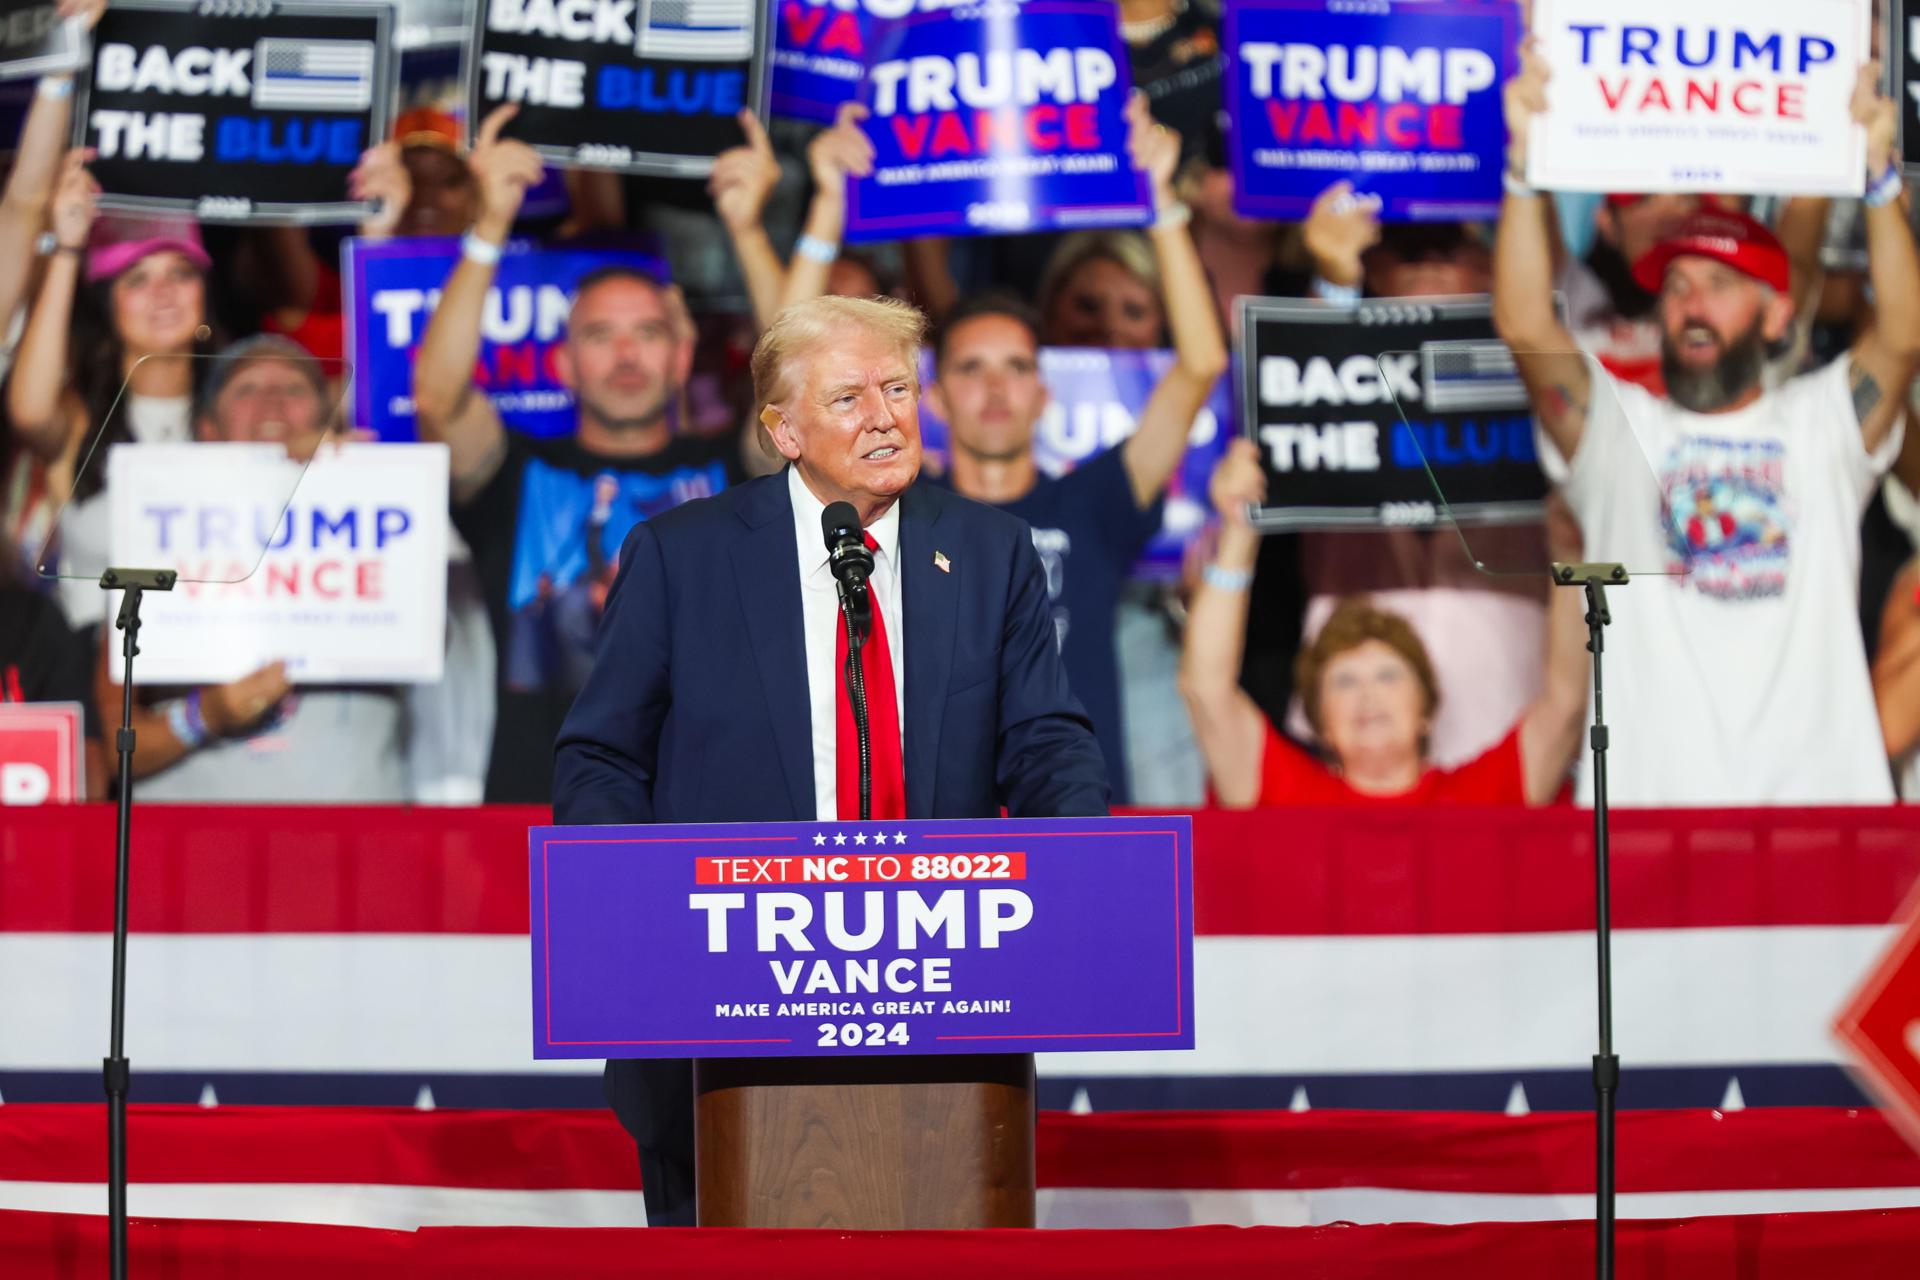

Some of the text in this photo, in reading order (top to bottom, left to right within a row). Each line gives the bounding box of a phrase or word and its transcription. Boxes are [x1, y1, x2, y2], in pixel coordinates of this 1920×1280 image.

[96, 43, 253, 96] BACK
[1239, 42, 1496, 105] TRUMP
[1568, 24, 1836, 73] TRUMP
[484, 52, 586, 108] THE
[596, 64, 746, 116] BLUE
[870, 47, 1117, 116] TRUMP
[1599, 78, 1806, 118] VANCE
[91, 110, 363, 164] THE BLUE
[892, 103, 1100, 159] VANCE
[1265, 98, 1464, 148] VANCE
[1259, 354, 1422, 406] BACK
[1258, 420, 1380, 473] THE
[1390, 416, 1537, 468] BLUE
[144, 505, 412, 550] TRUMP
[711, 854, 1010, 883] TEXT NC TO 88022
[689, 888, 1034, 953] TRUMP
[769, 957, 952, 995] VANCE
[715, 999, 1012, 1017] MAKE AMERICA GREAT AGAIN!
[817, 1022, 910, 1047] 2024
